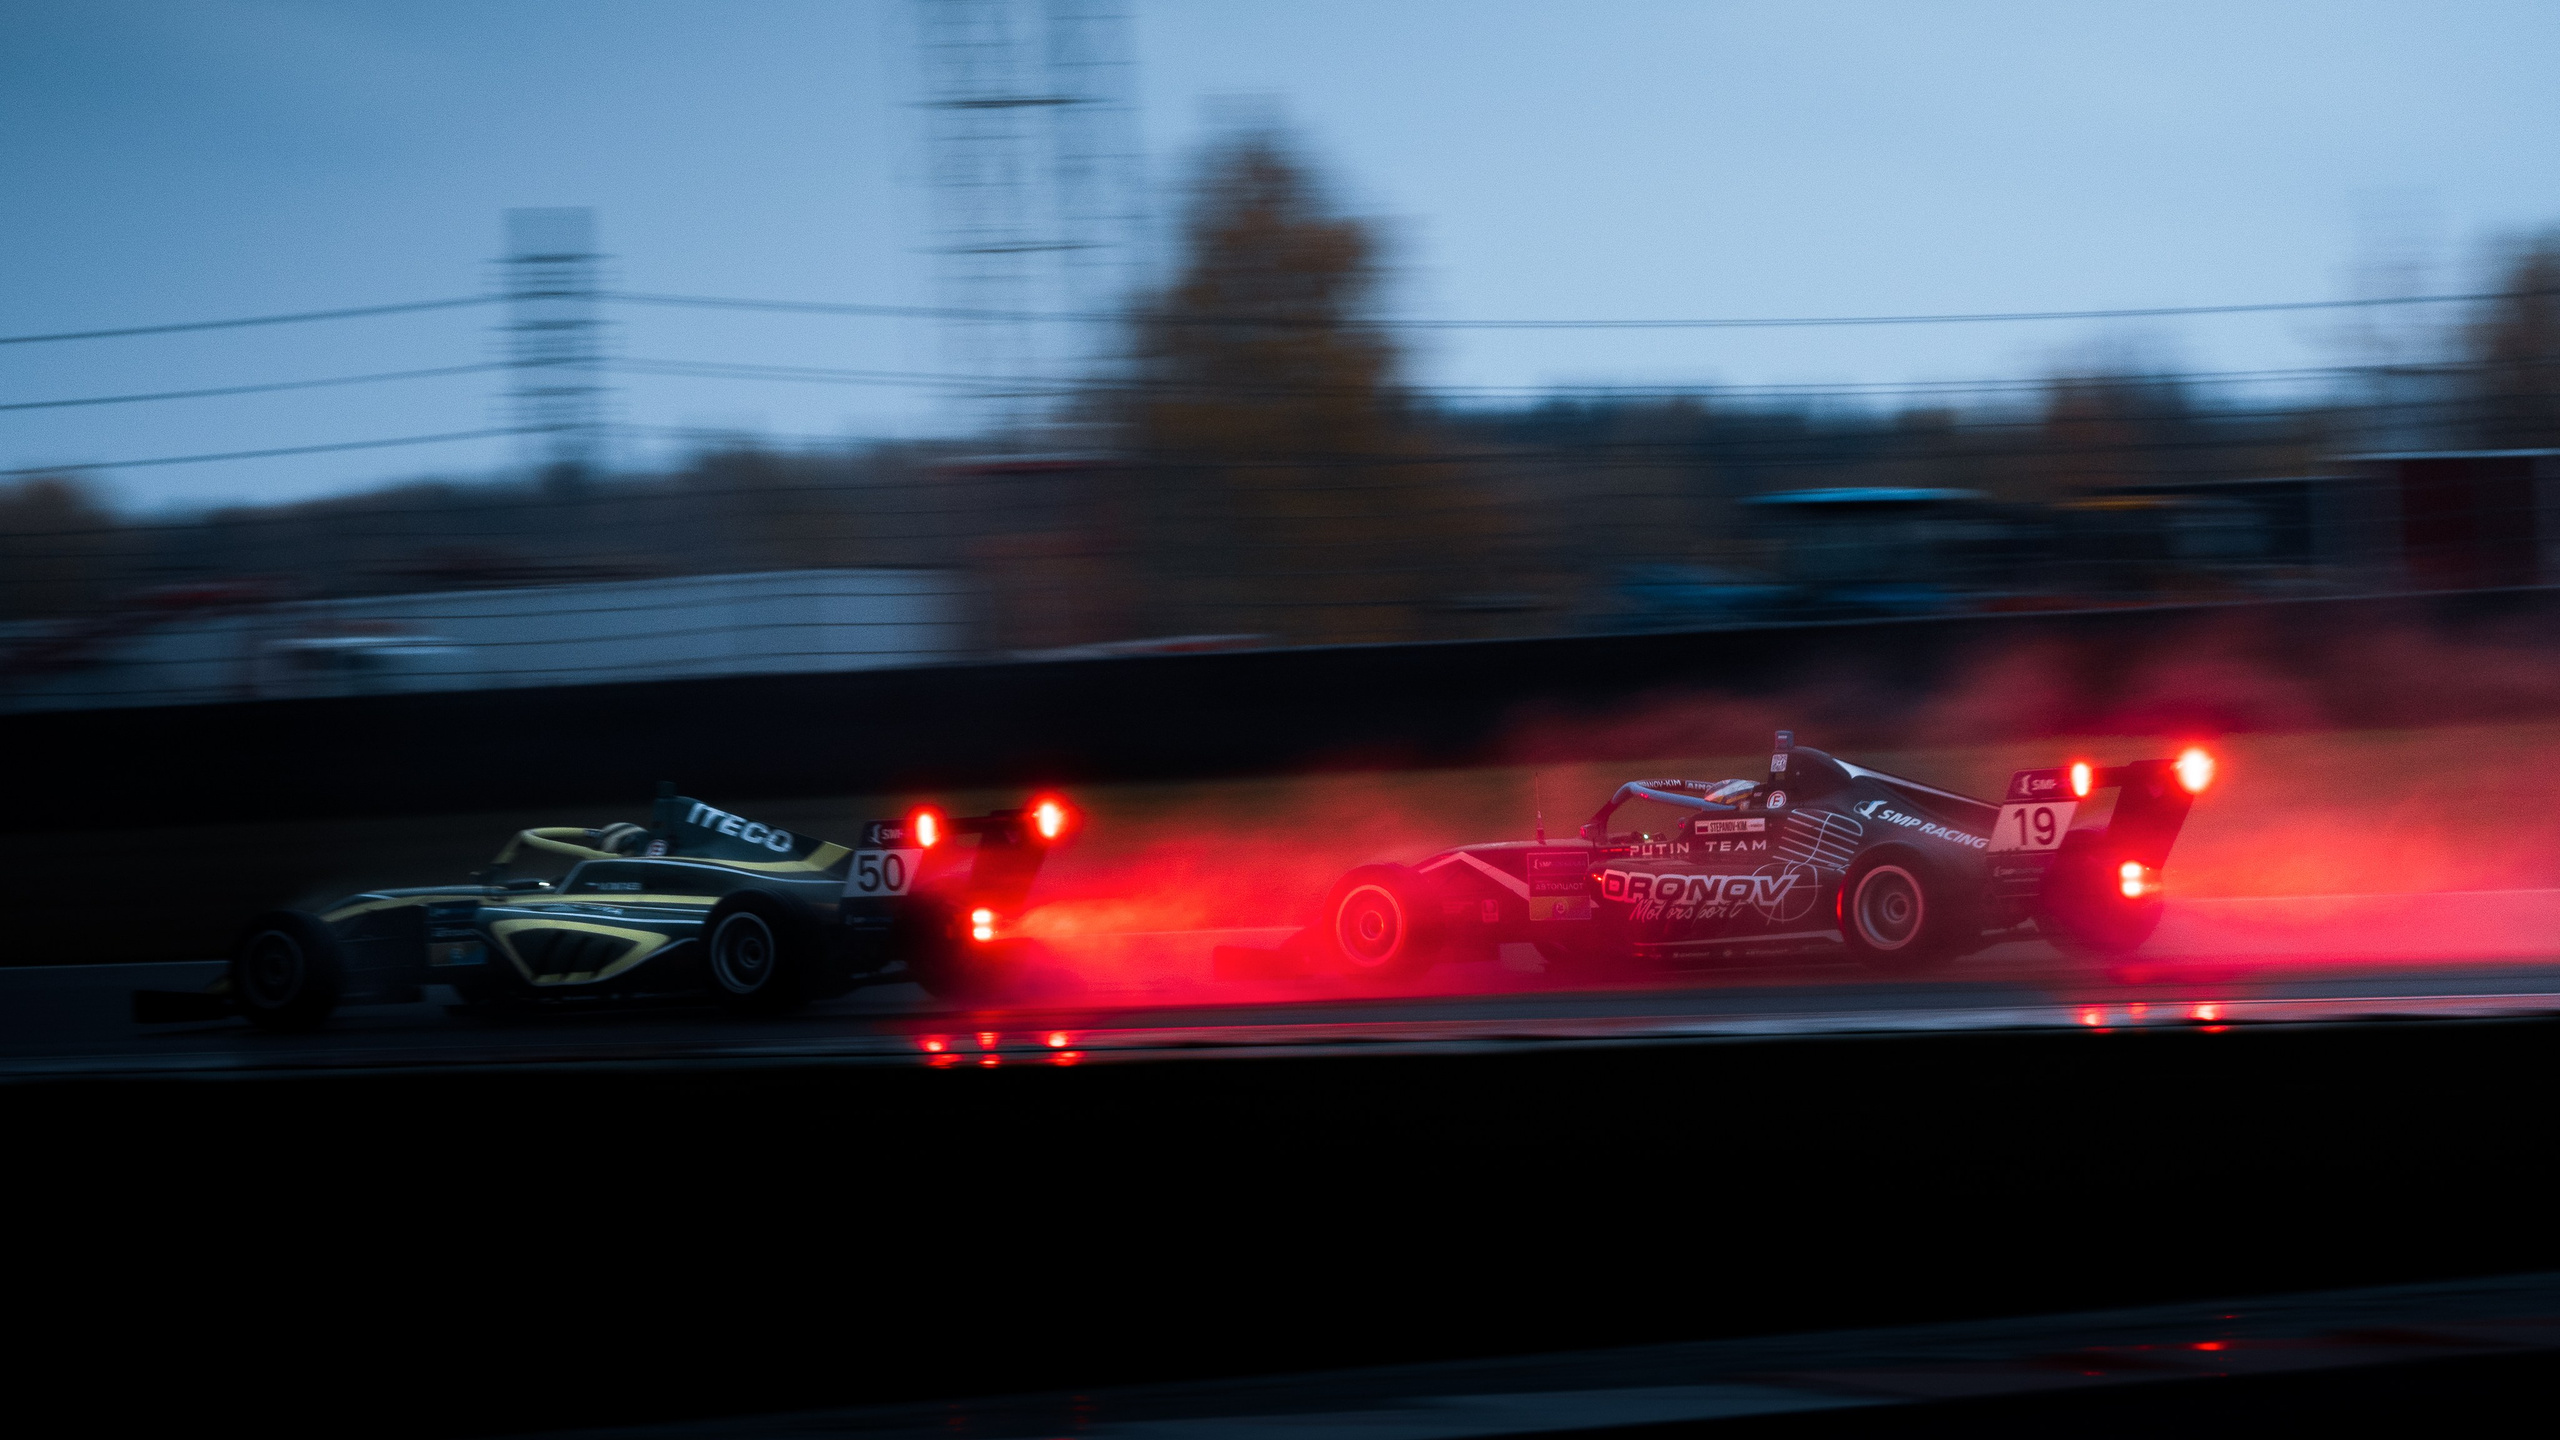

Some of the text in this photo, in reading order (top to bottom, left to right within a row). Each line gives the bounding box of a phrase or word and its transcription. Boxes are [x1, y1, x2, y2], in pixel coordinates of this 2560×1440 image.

[686, 802, 795, 853] ITECO
[1877, 809, 1990, 849] SMP RACING
[2012, 806, 2056, 846] 19
[1629, 839, 1767, 857] PUTIN TEAM
[857, 853, 906, 892] 50
[1602, 868, 1801, 907] DRONOV
